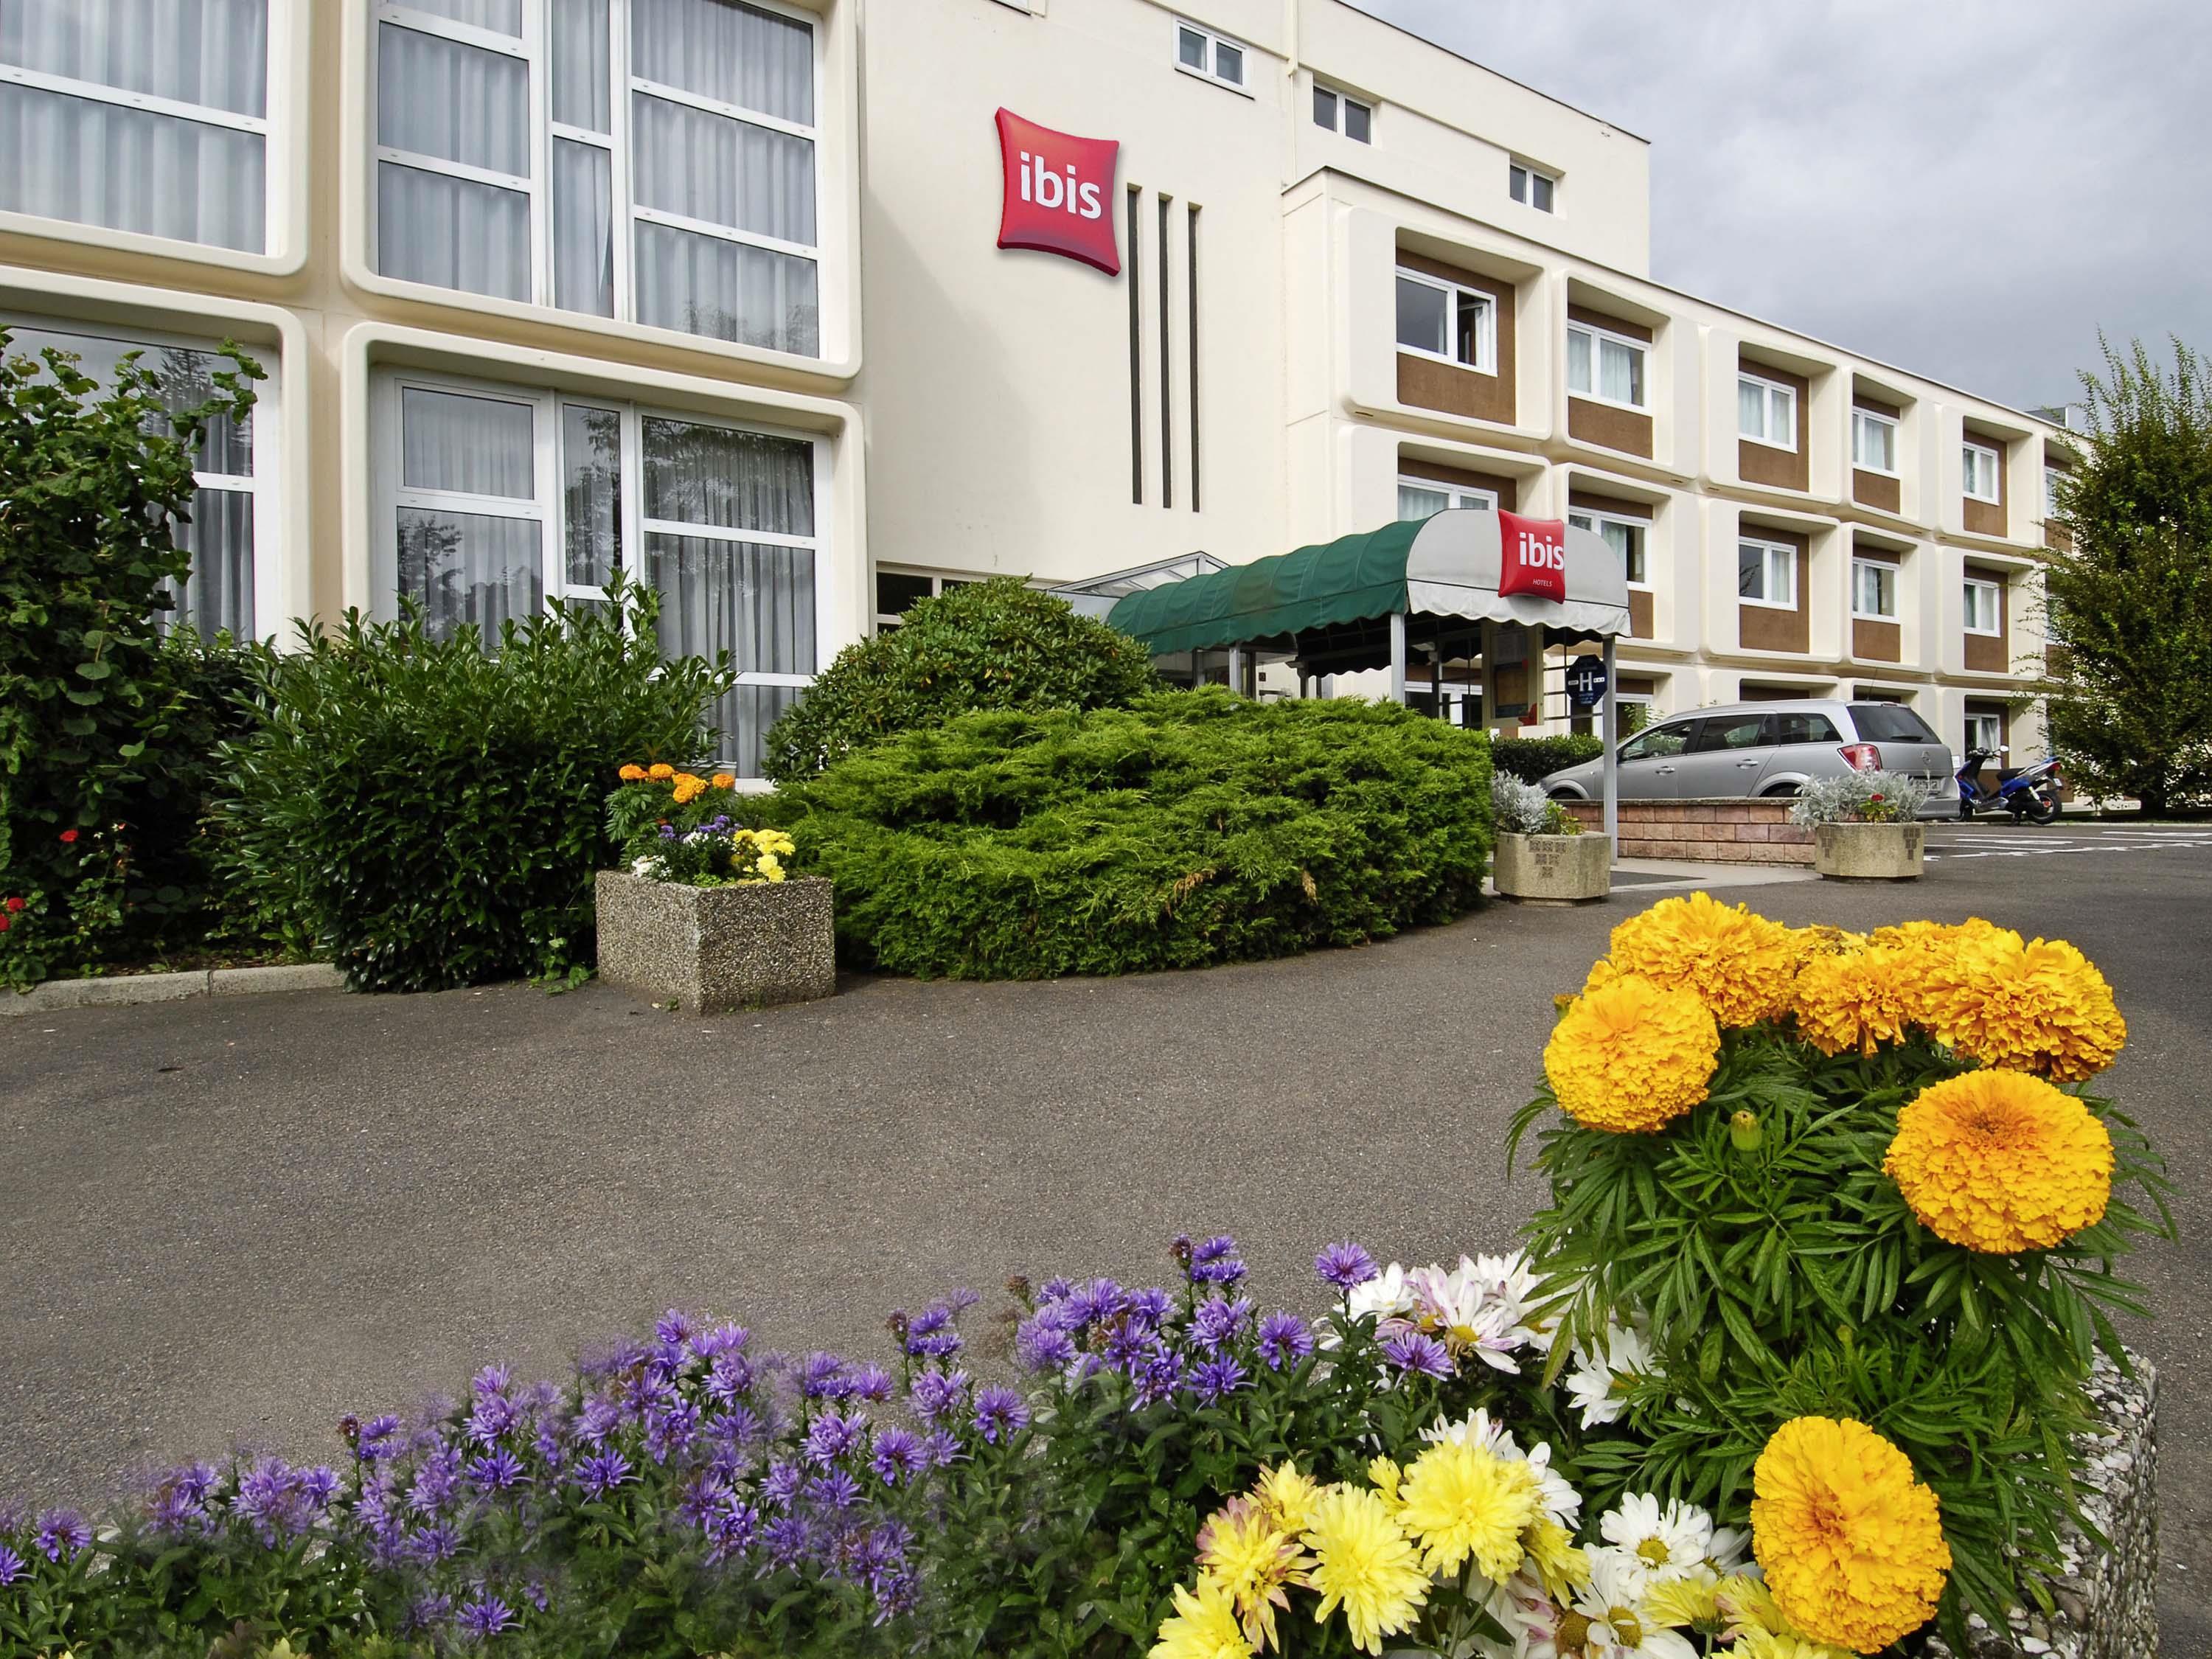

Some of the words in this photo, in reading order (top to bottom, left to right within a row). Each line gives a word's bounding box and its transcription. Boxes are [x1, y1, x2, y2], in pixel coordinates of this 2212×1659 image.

[1020, 150, 1102, 219] ibis
[1519, 532, 1564, 571] ibis
[1533, 579, 1552, 588] HOTELS
[1579, 671, 1593, 692] H
